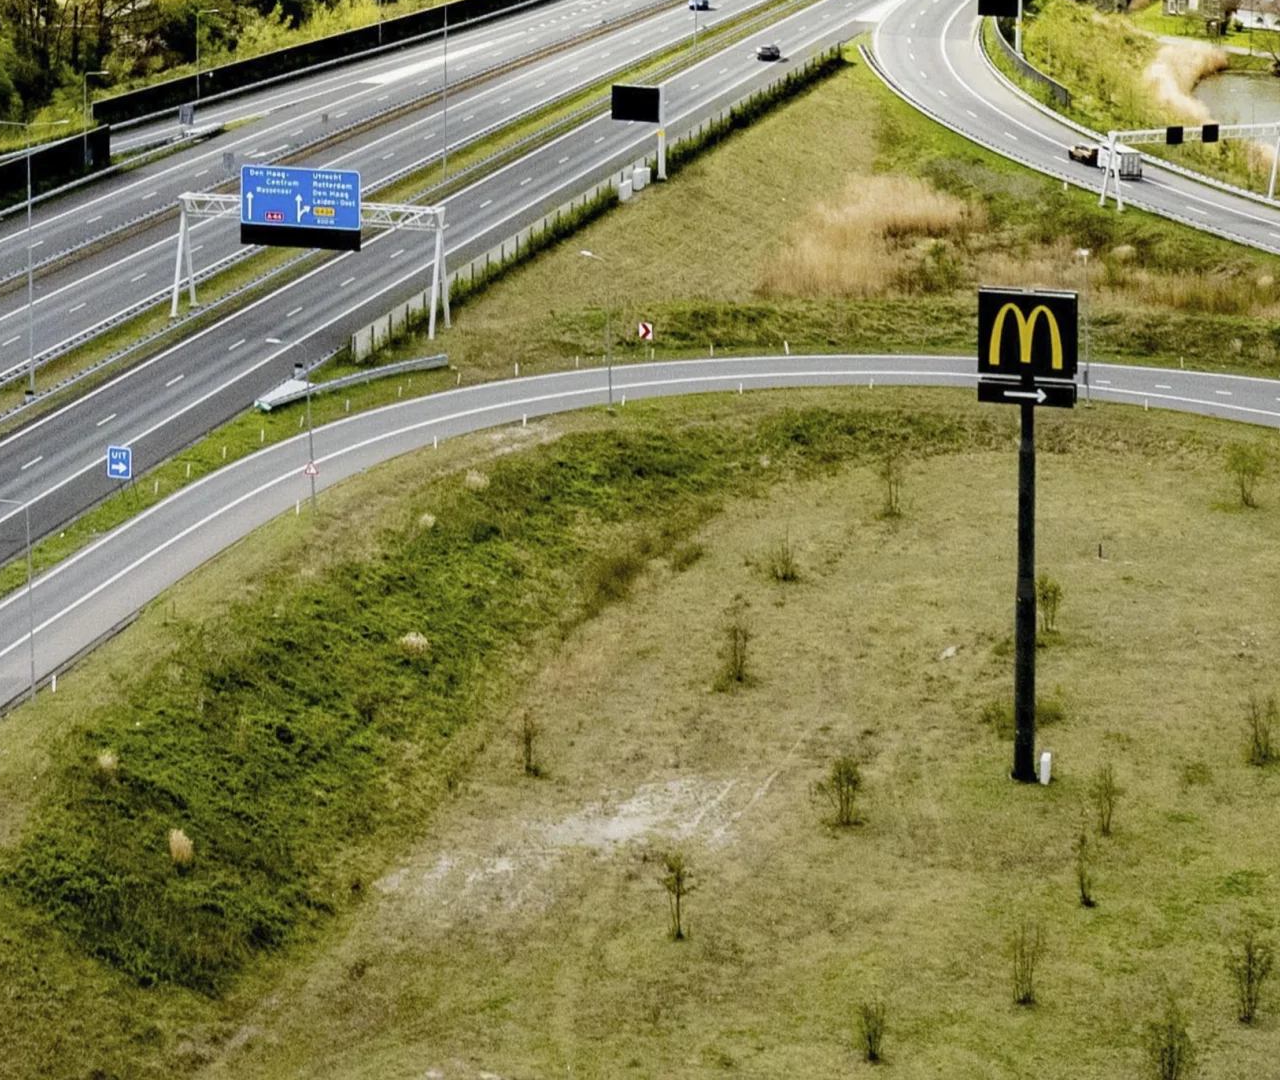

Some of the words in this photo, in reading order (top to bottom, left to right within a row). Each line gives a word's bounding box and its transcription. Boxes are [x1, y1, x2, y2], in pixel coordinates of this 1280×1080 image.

[250, 169, 264, 177] Den
[313, 173, 342, 181] Utrecht
[266, 178, 300, 187] Centrum
[312, 181, 353, 190] Rotterdam
[256, 186, 292, 194] Wassenaar
[312, 189, 327, 197] Den
[329, 191, 349, 200] Haag
[111, 450, 126, 460] UIT
